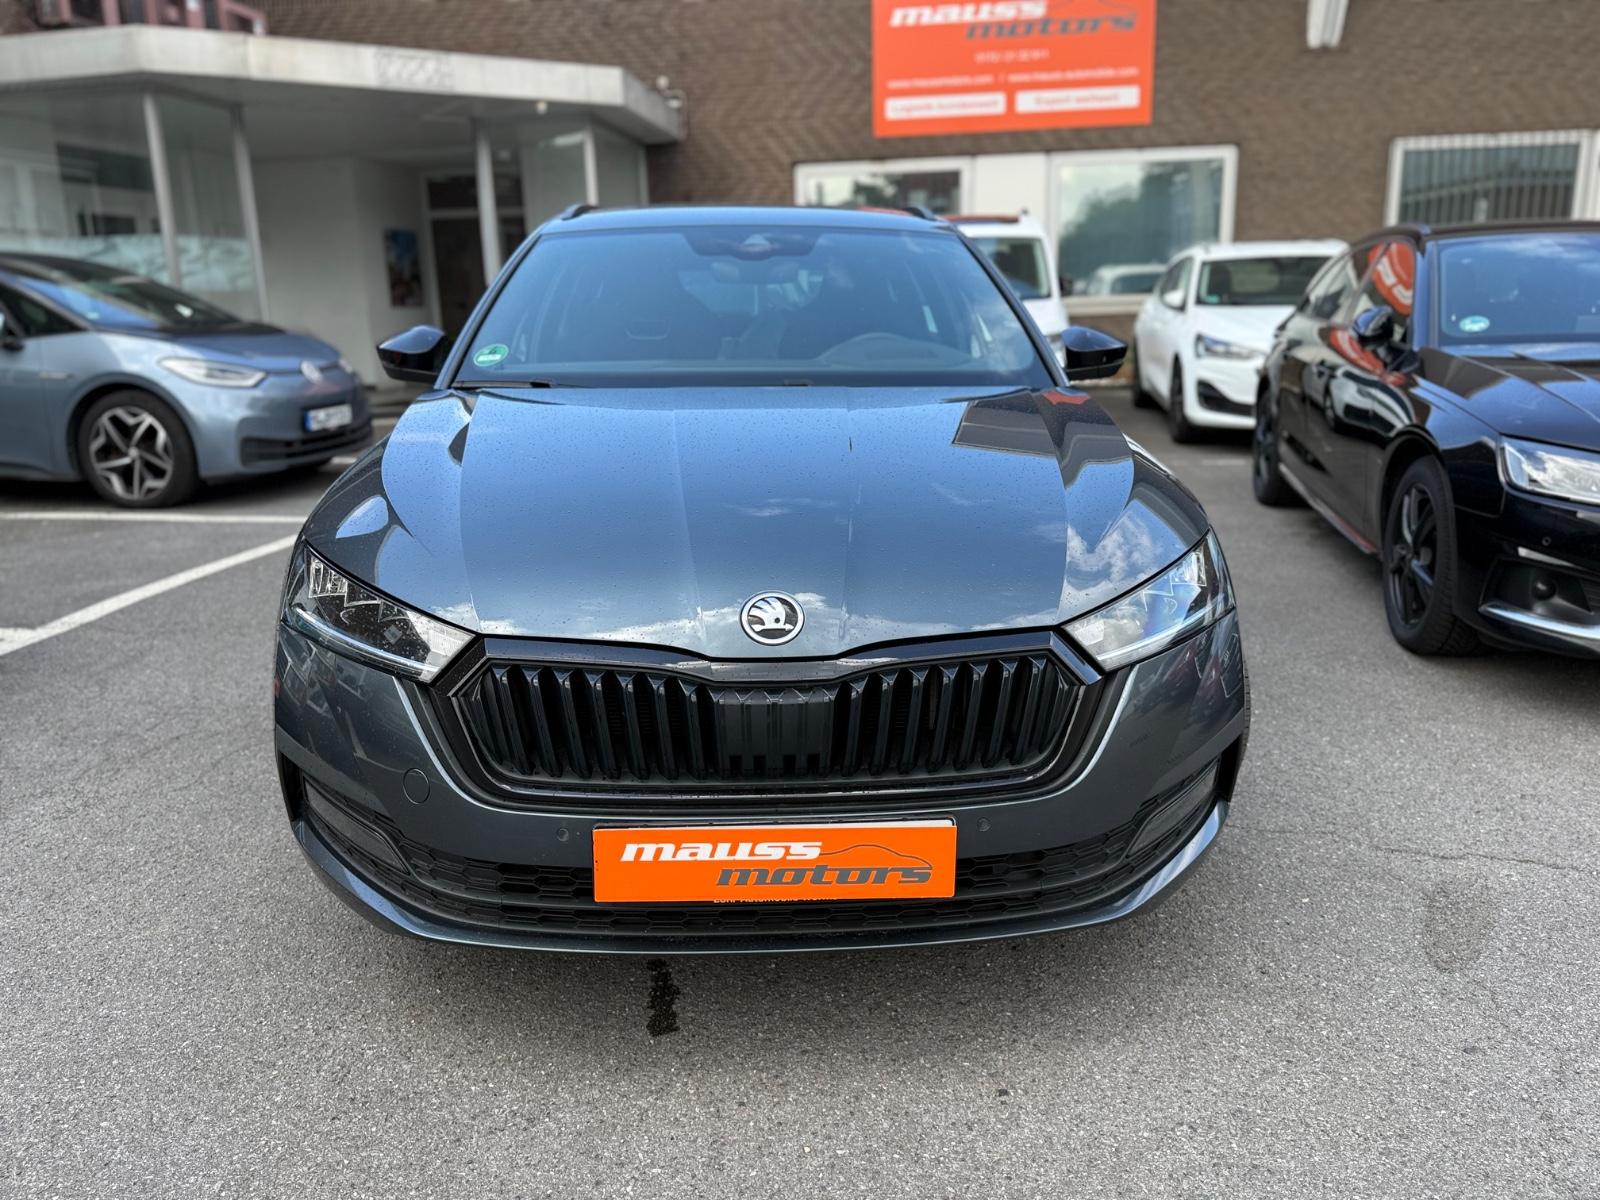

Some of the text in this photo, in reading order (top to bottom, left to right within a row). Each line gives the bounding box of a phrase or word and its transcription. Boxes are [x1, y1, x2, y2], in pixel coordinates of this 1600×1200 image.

[889, 0, 1048, 27] mauss
[965, 15, 1136, 40] motors
[620, 841, 823, 862] mauss
[715, 864, 933, 887] motors
